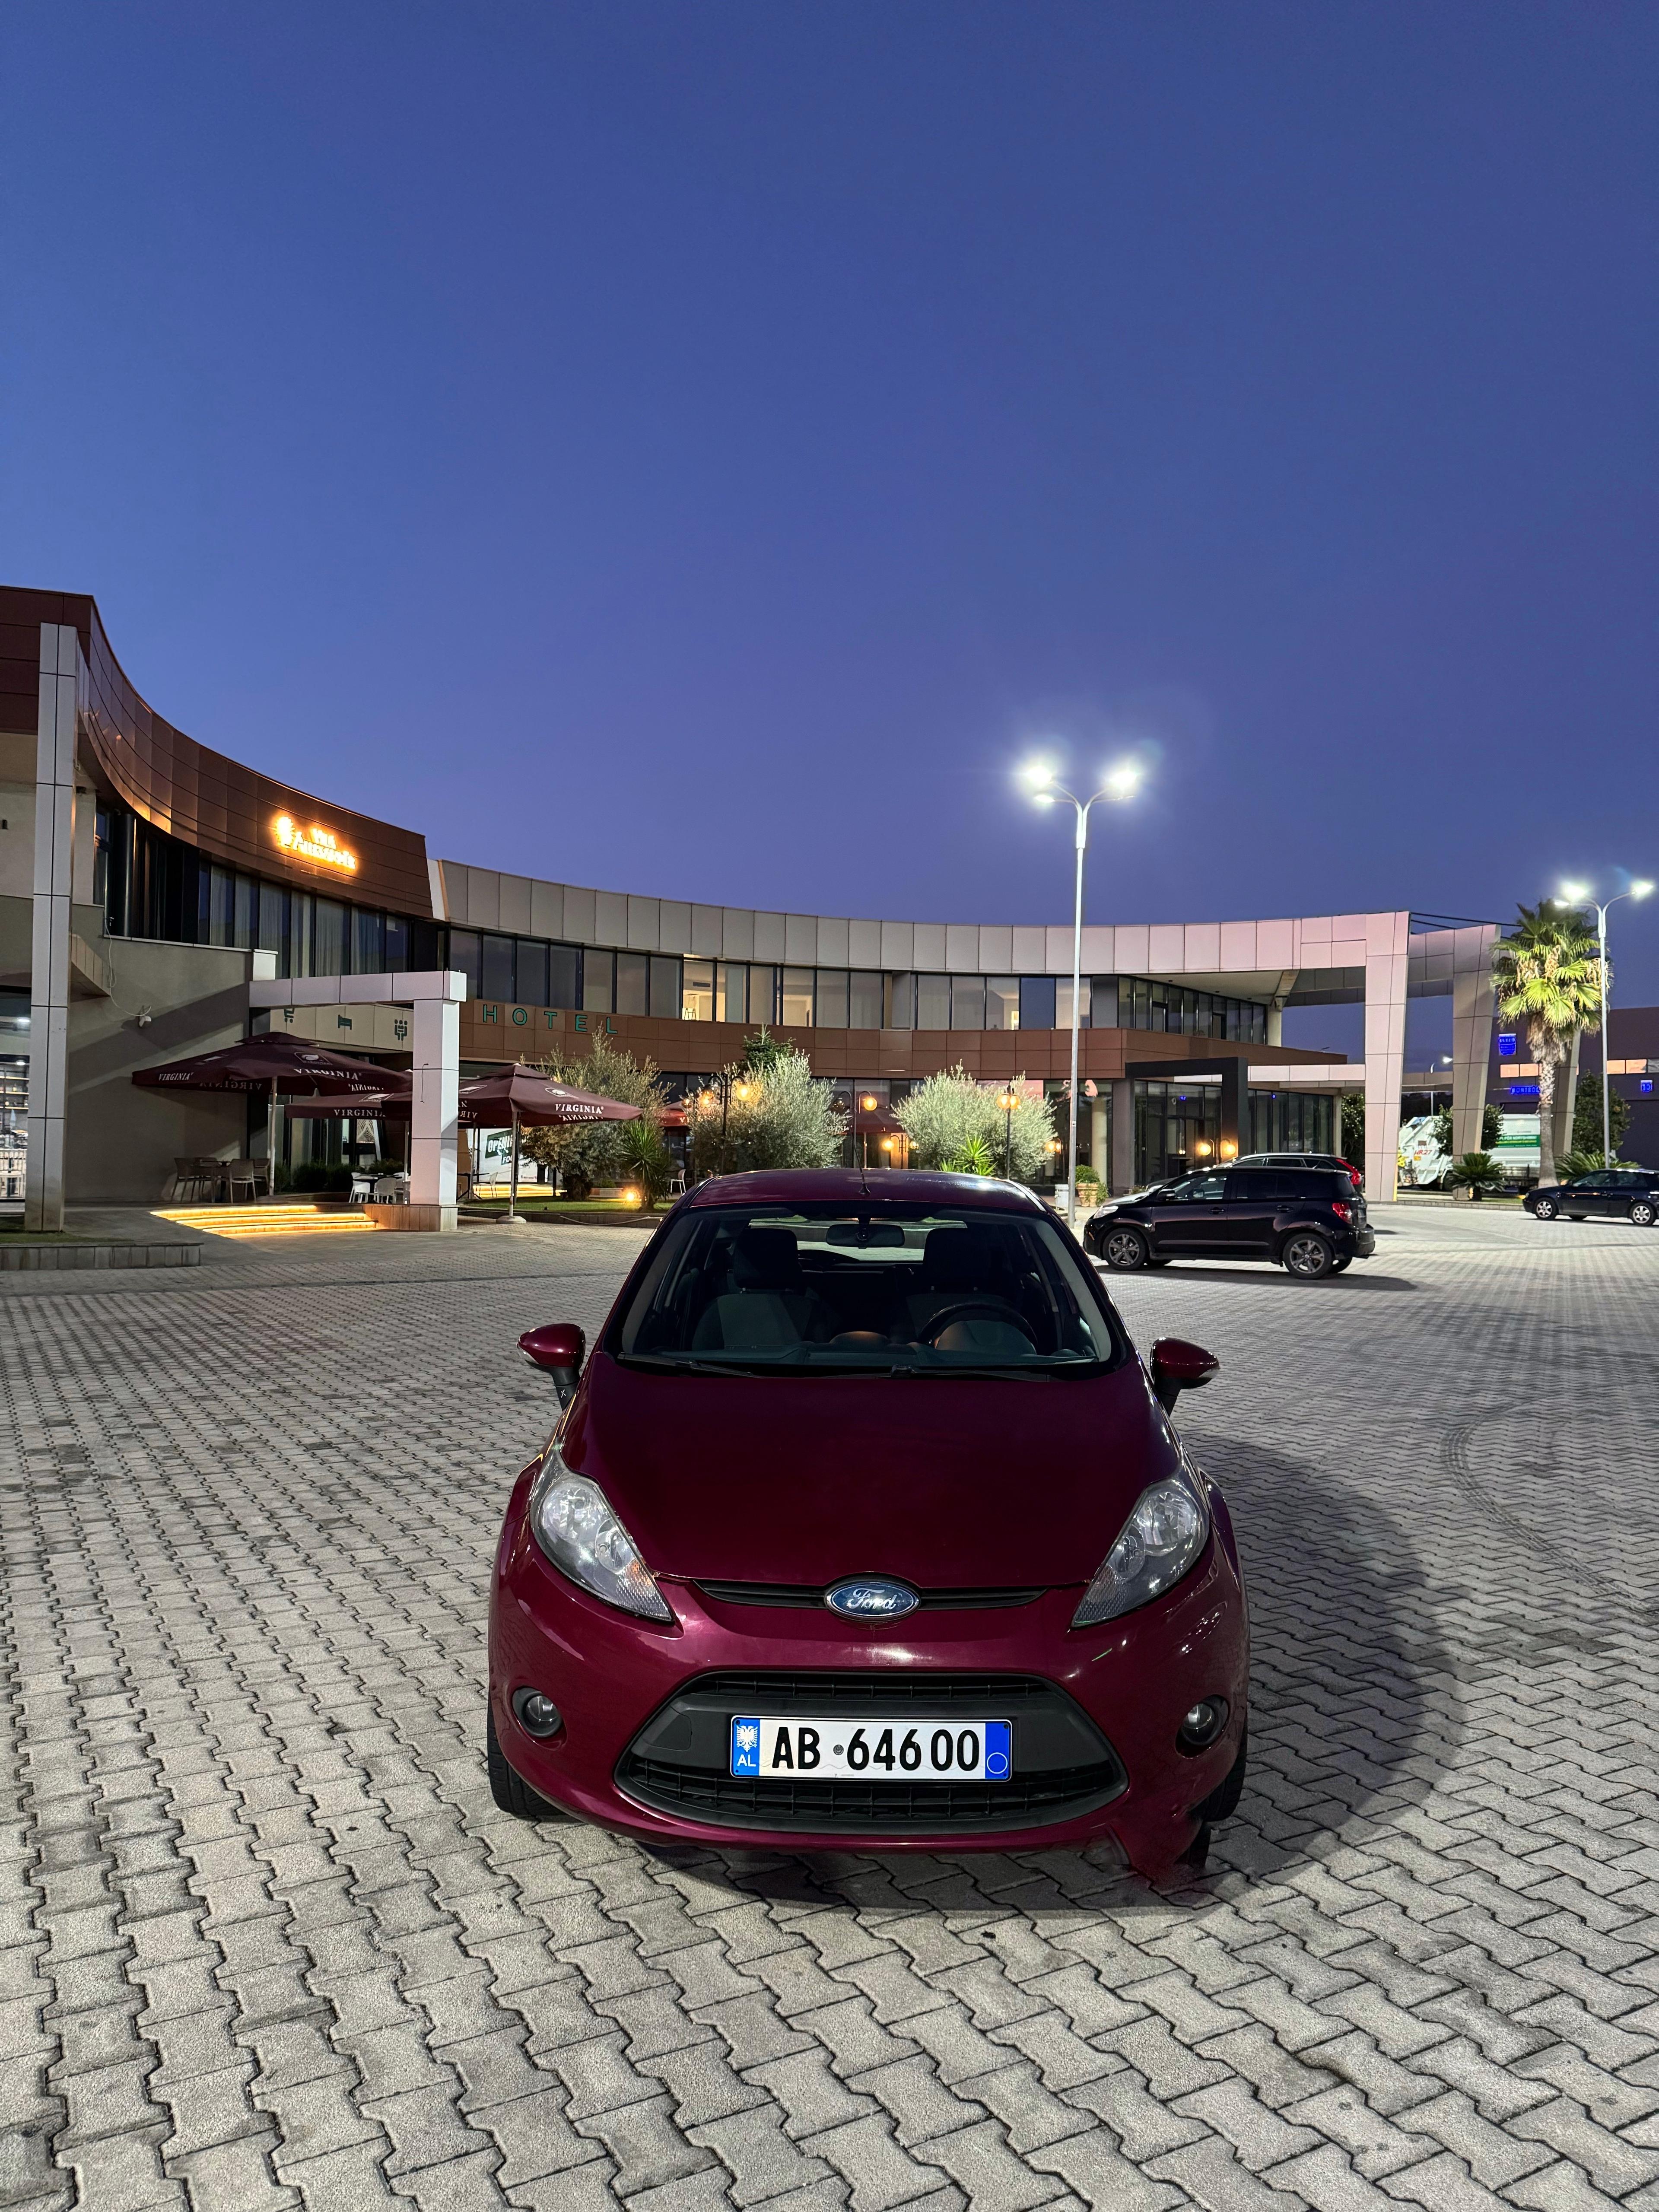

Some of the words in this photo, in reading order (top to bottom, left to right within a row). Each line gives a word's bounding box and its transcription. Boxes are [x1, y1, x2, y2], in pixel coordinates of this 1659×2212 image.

[483, 1004, 618, 1034] HOTEL
[158, 1072, 192, 1081] VIRGINIA
[555, 1103, 602, 1114] VIRGINIA
[846, 1588, 898, 1610] Ford
[772, 1726, 820, 1769] AB
[737, 1754, 756, 1767] AL
